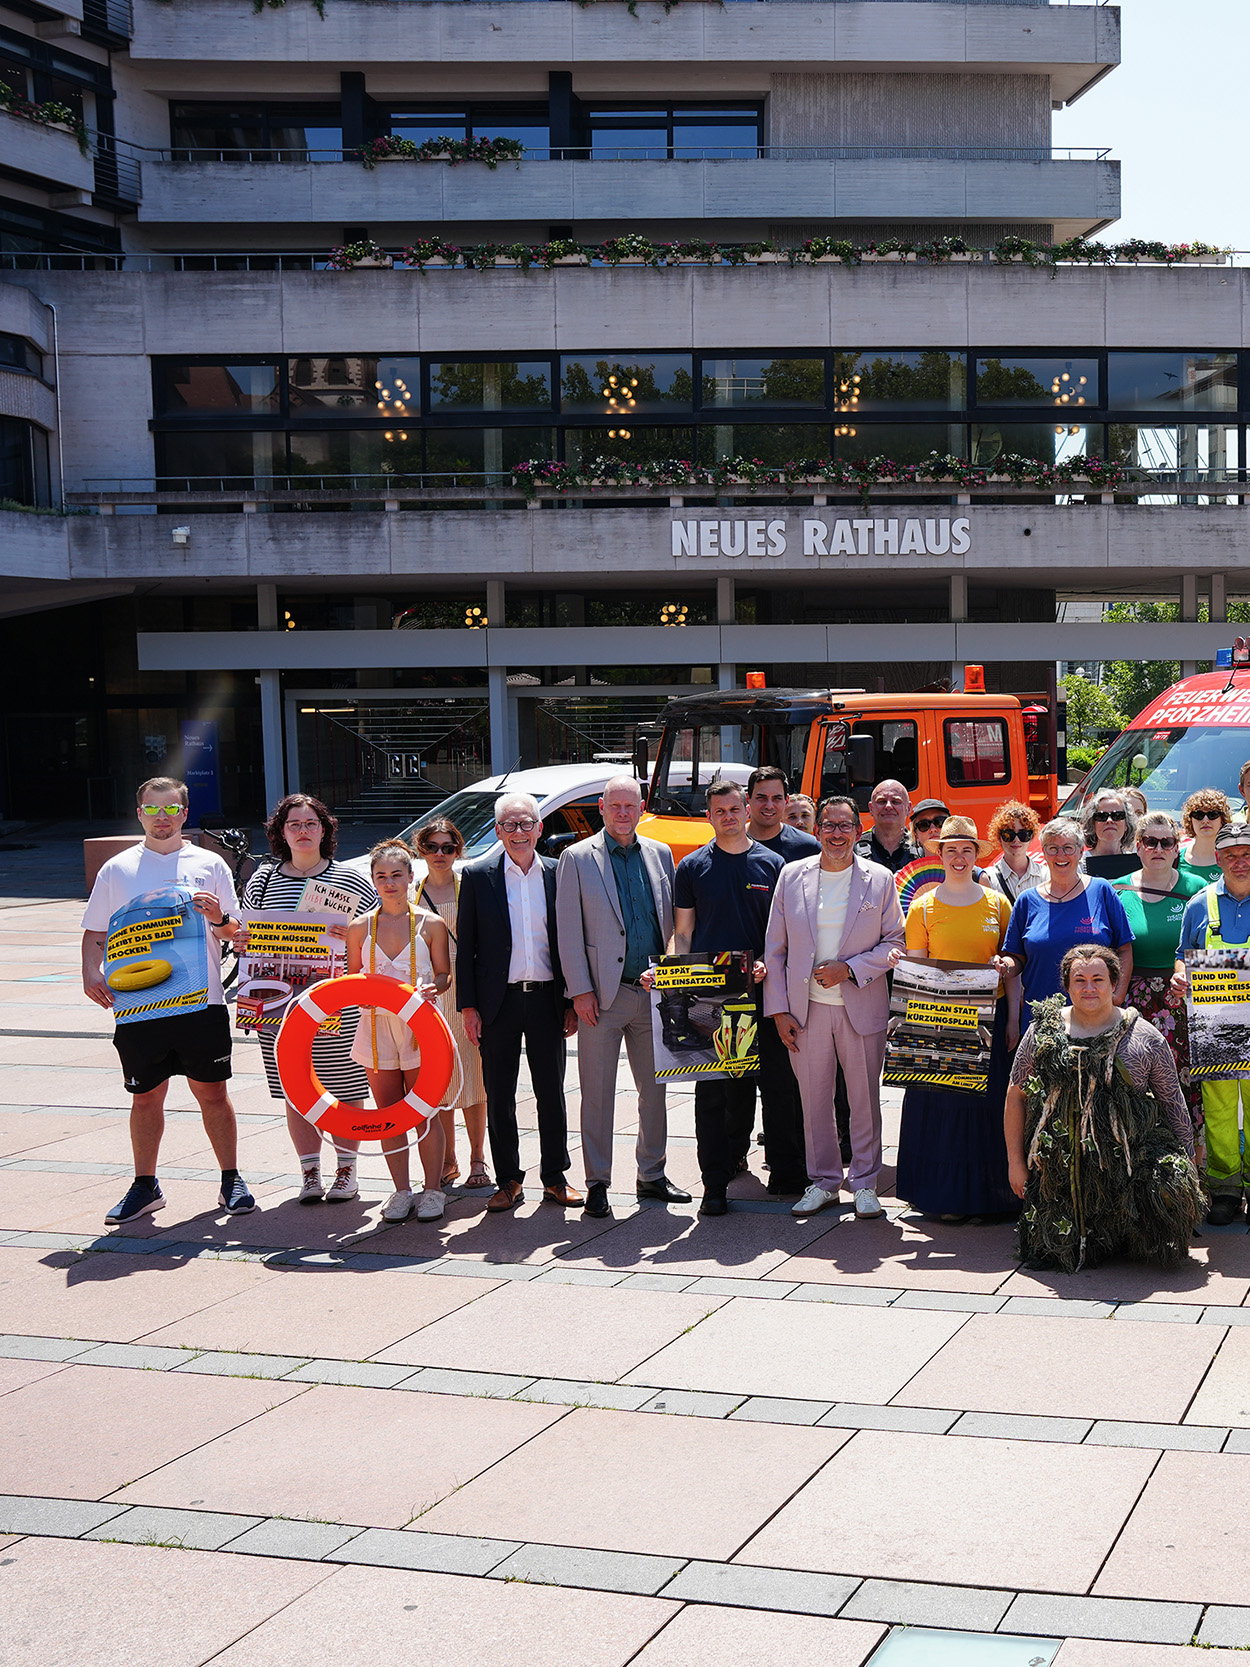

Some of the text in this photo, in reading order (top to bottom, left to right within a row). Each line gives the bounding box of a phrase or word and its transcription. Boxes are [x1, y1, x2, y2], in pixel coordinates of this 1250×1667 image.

[671, 518, 972, 557] NEUES RATHAUS
[314, 884, 351, 903] ICH HASSE
[108, 918, 181, 943] OHNE KOMMUNEN
[276, 924, 326, 932] KOMMUNEN
[108, 930, 172, 951] BLEIBT DAS BAD
[282, 935, 318, 943] MÜSSEN,
[107, 946, 151, 960] TROCKEN.
[247, 944, 328, 954] ENTSTEHEN LÜCKEN.
[670, 966, 690, 975] SPÄT
[672, 976, 725, 985] EINSATZORT.
[908, 1002, 978, 1015] SPIELPLAN STATT
[907, 1012, 977, 1027] KÜRZUNGSPLAN.
[352, 1123, 382, 1131] Golfinho
